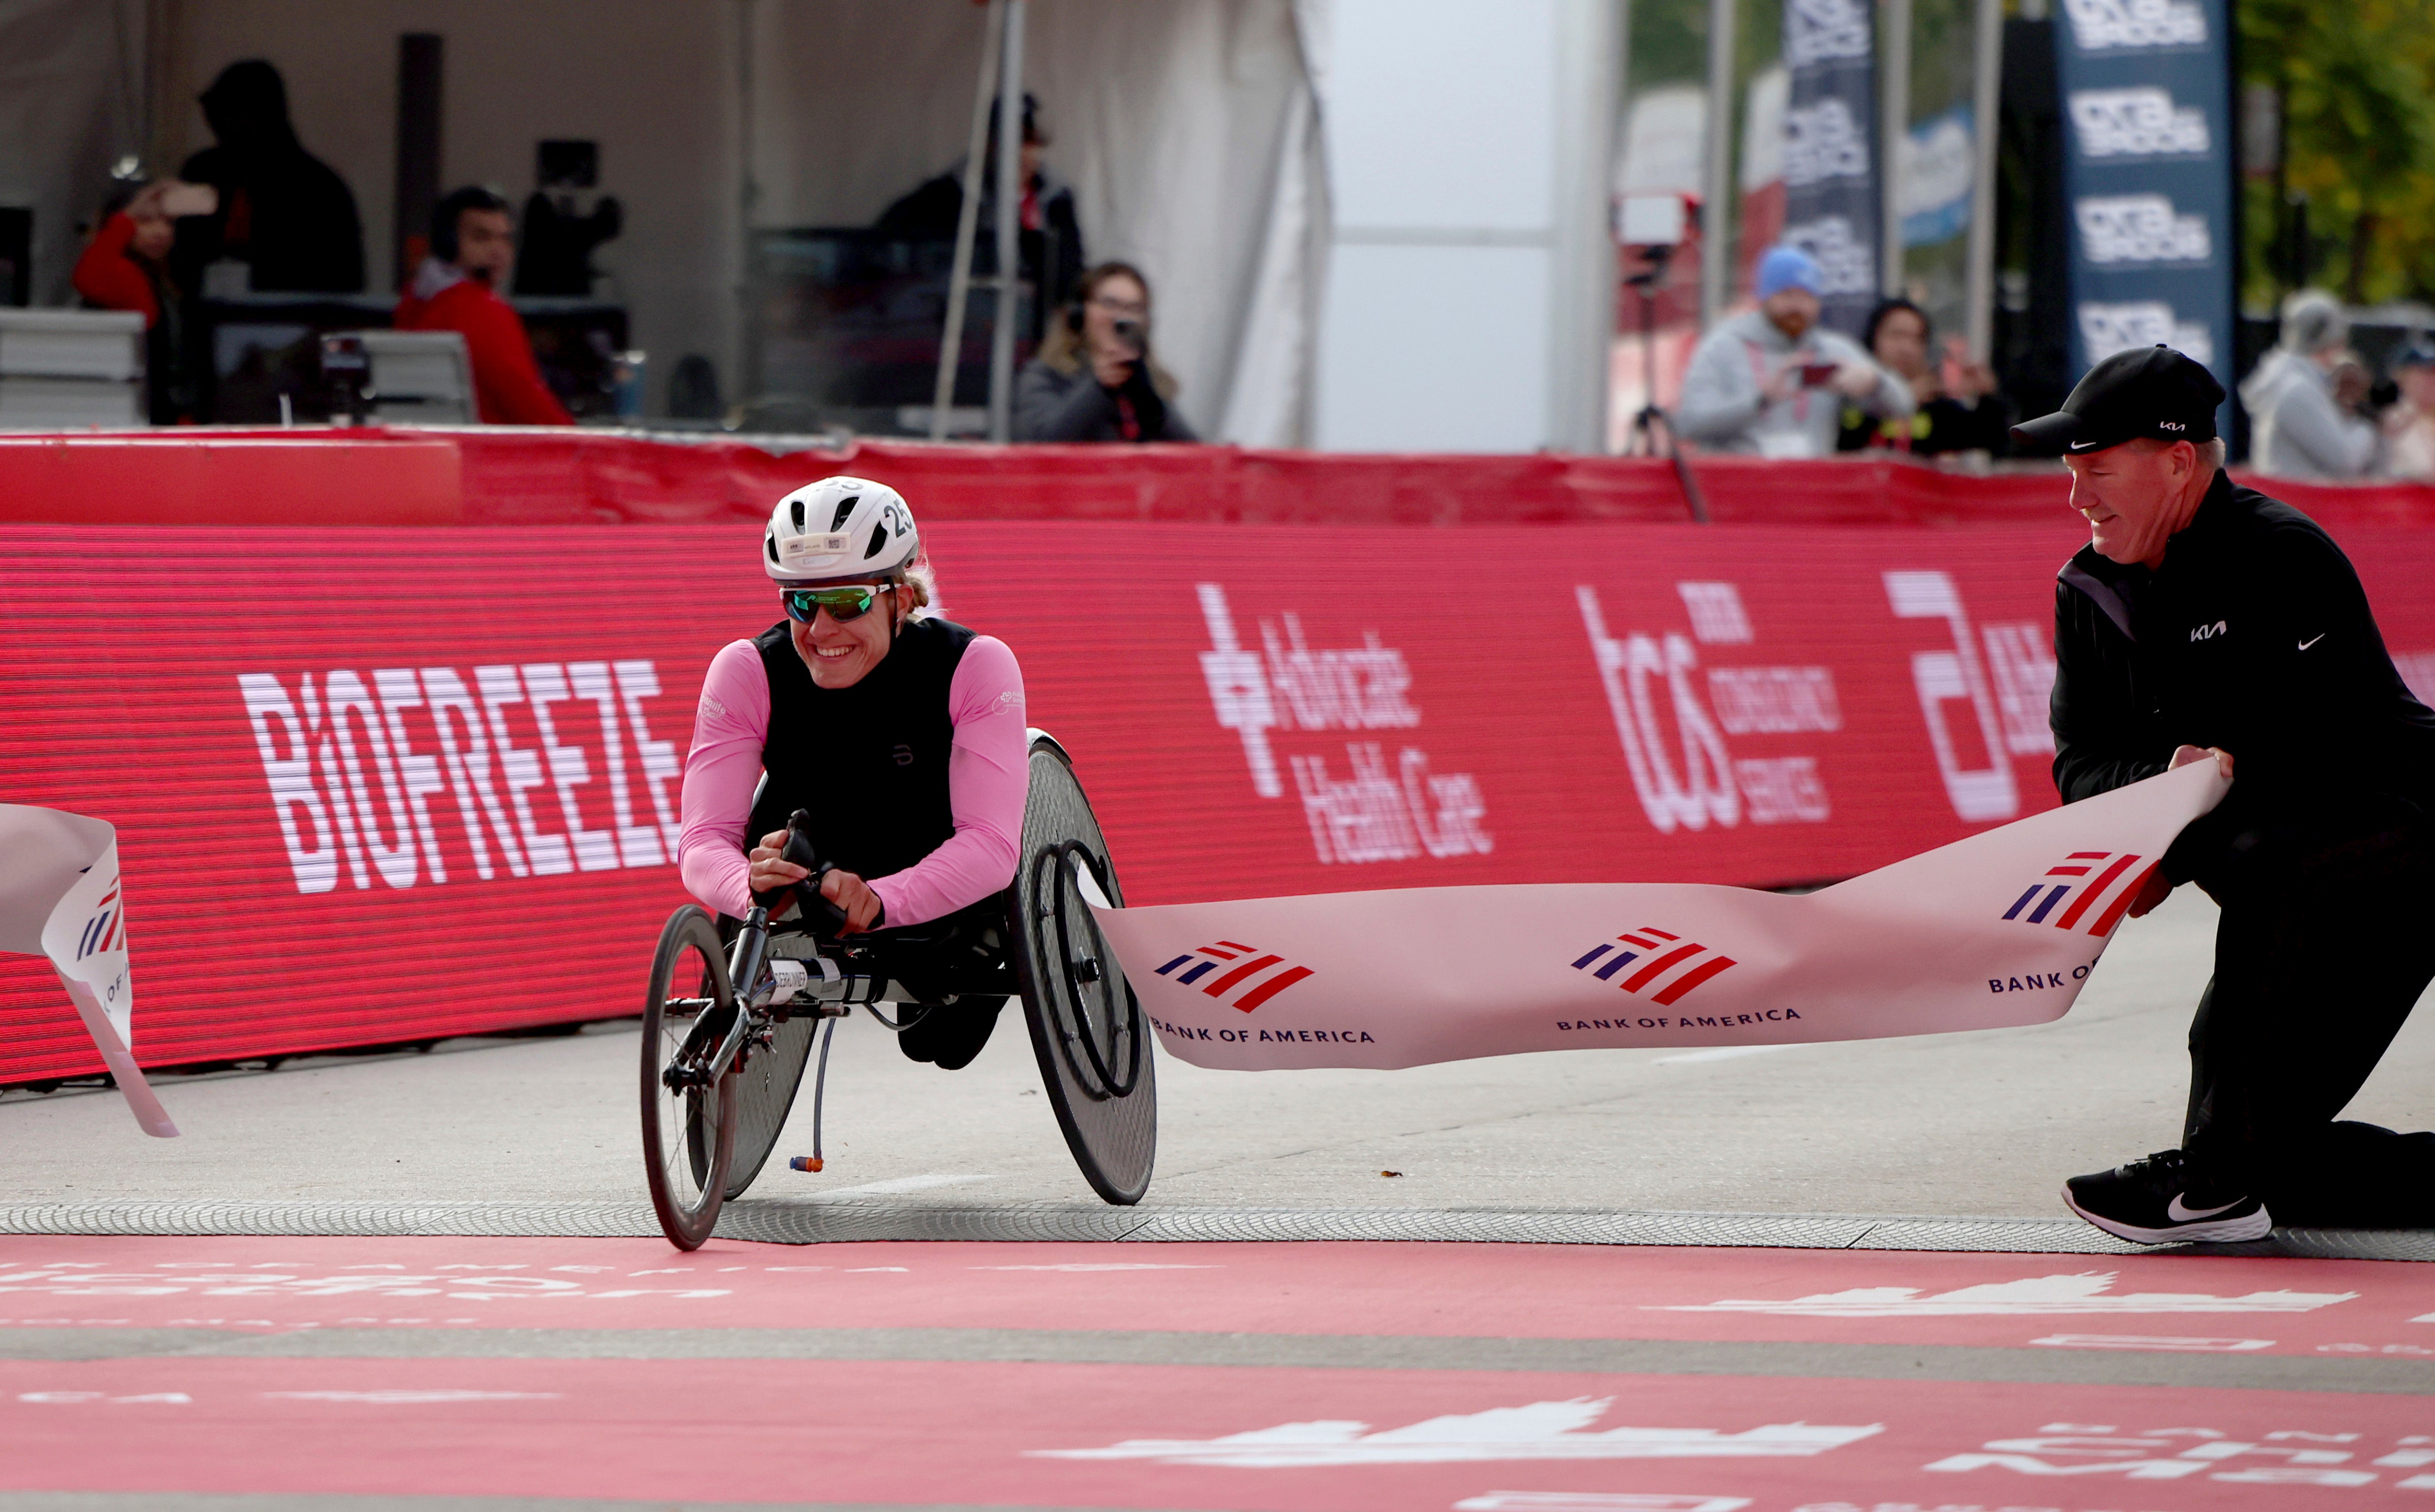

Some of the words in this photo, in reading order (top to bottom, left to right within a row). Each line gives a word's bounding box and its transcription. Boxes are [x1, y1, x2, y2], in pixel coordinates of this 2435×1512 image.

[884, 499, 912, 538] 25
[1989, 972, 2065, 993] BANK
[1150, 1016, 1213, 1041] BANK
[1219, 1029, 1249, 1042] OF
[1260, 1030, 1375, 1043] AMERICA
[1557, 1018, 1630, 1030] BANK
[1638, 1017, 1669, 1028] OF
[1680, 1008, 1801, 1028] AMERICA
